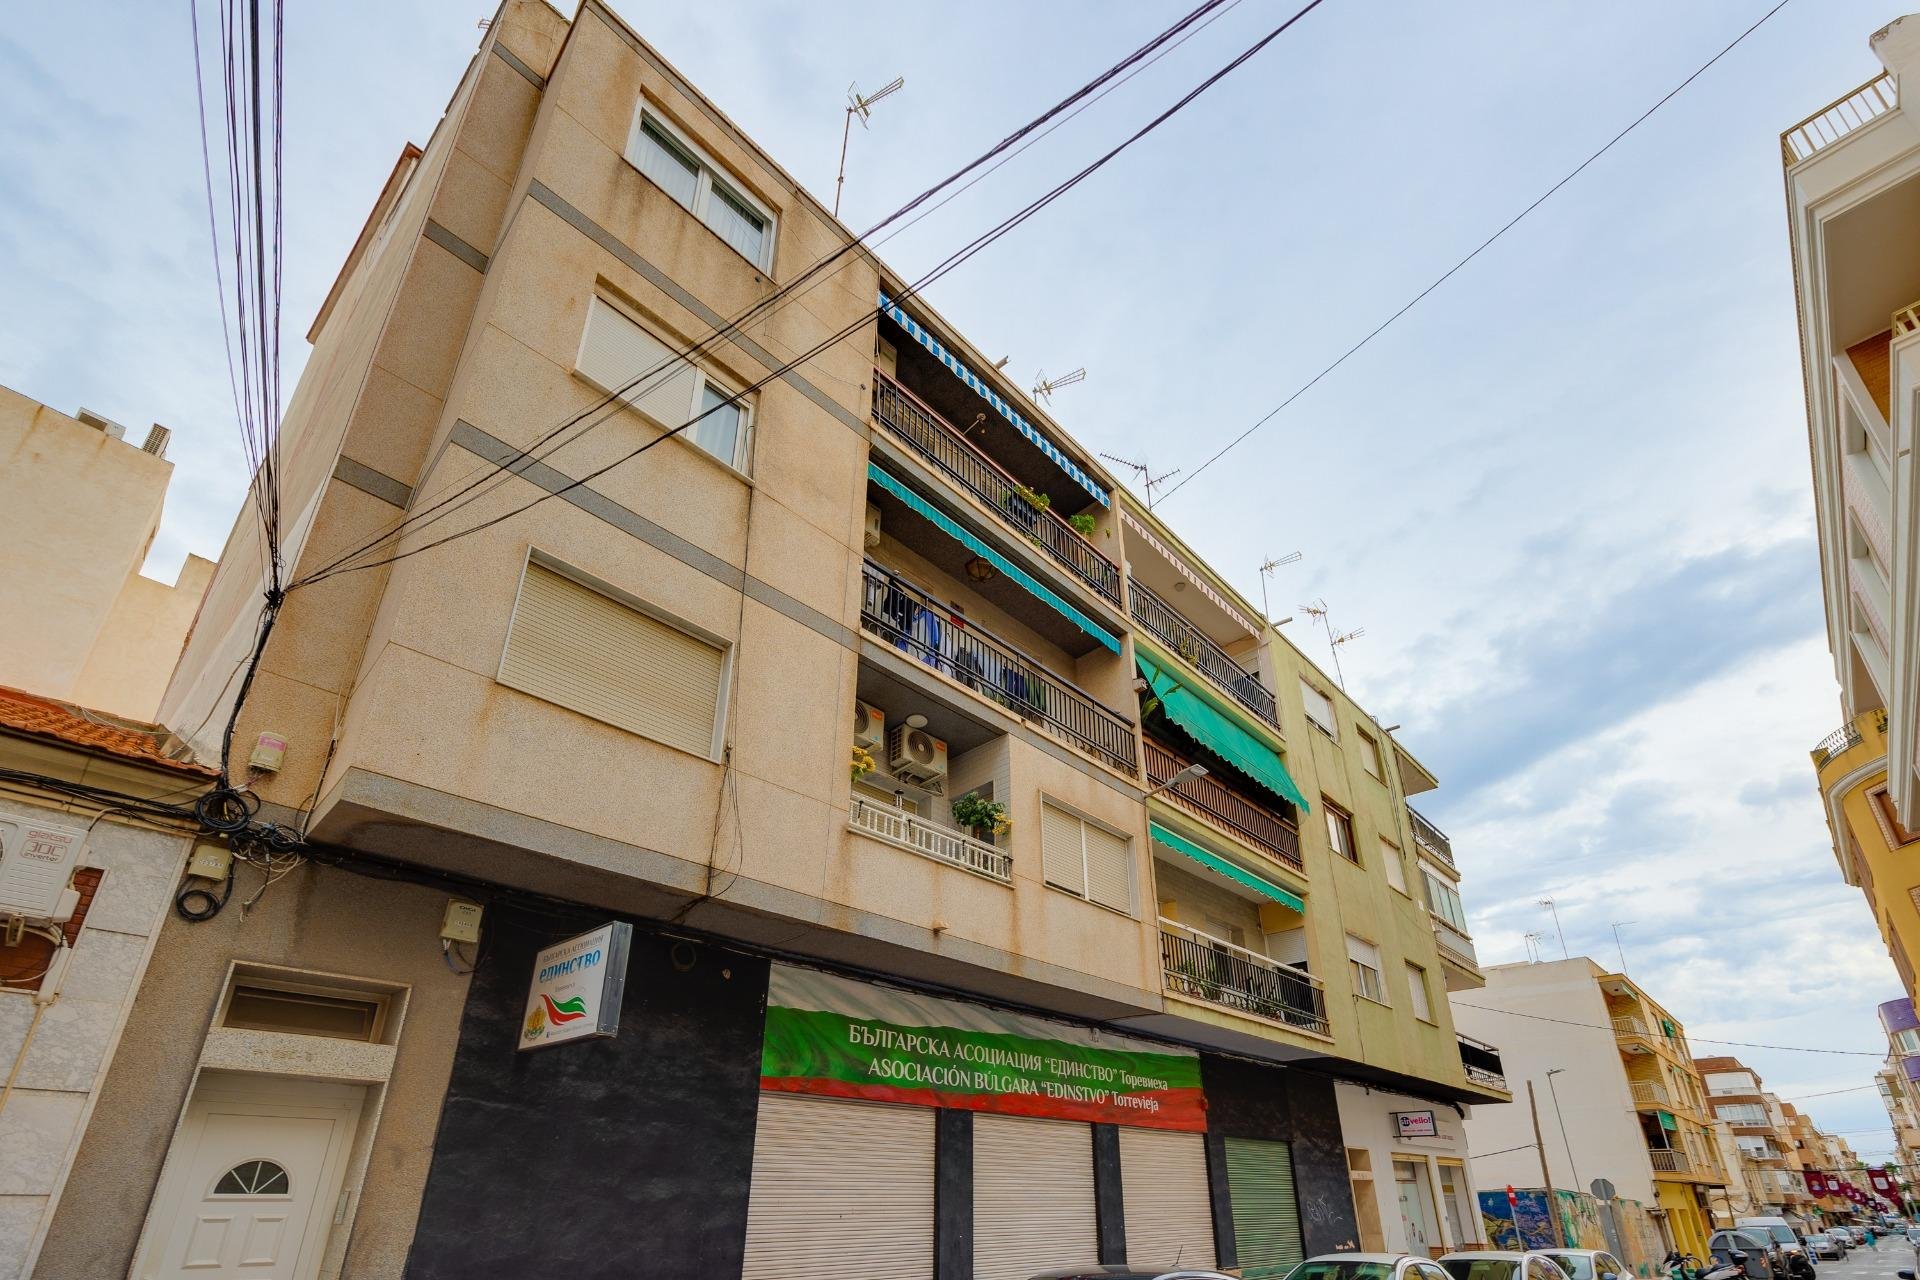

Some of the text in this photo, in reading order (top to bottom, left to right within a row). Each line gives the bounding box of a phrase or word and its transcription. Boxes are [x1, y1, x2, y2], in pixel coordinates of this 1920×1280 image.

[849, 1024, 951, 1058] БЪЛГАРСКА
[954, 1042, 1041, 1072] АСОЦИАЦИЯ
[1120, 1070, 1168, 1091] Торевиеха
[868, 1058, 970, 1089] ASOCIACIÓN
[974, 1071, 1038, 1096] BÚLGARA
[1112, 1091, 1159, 1114] Torrevieja
